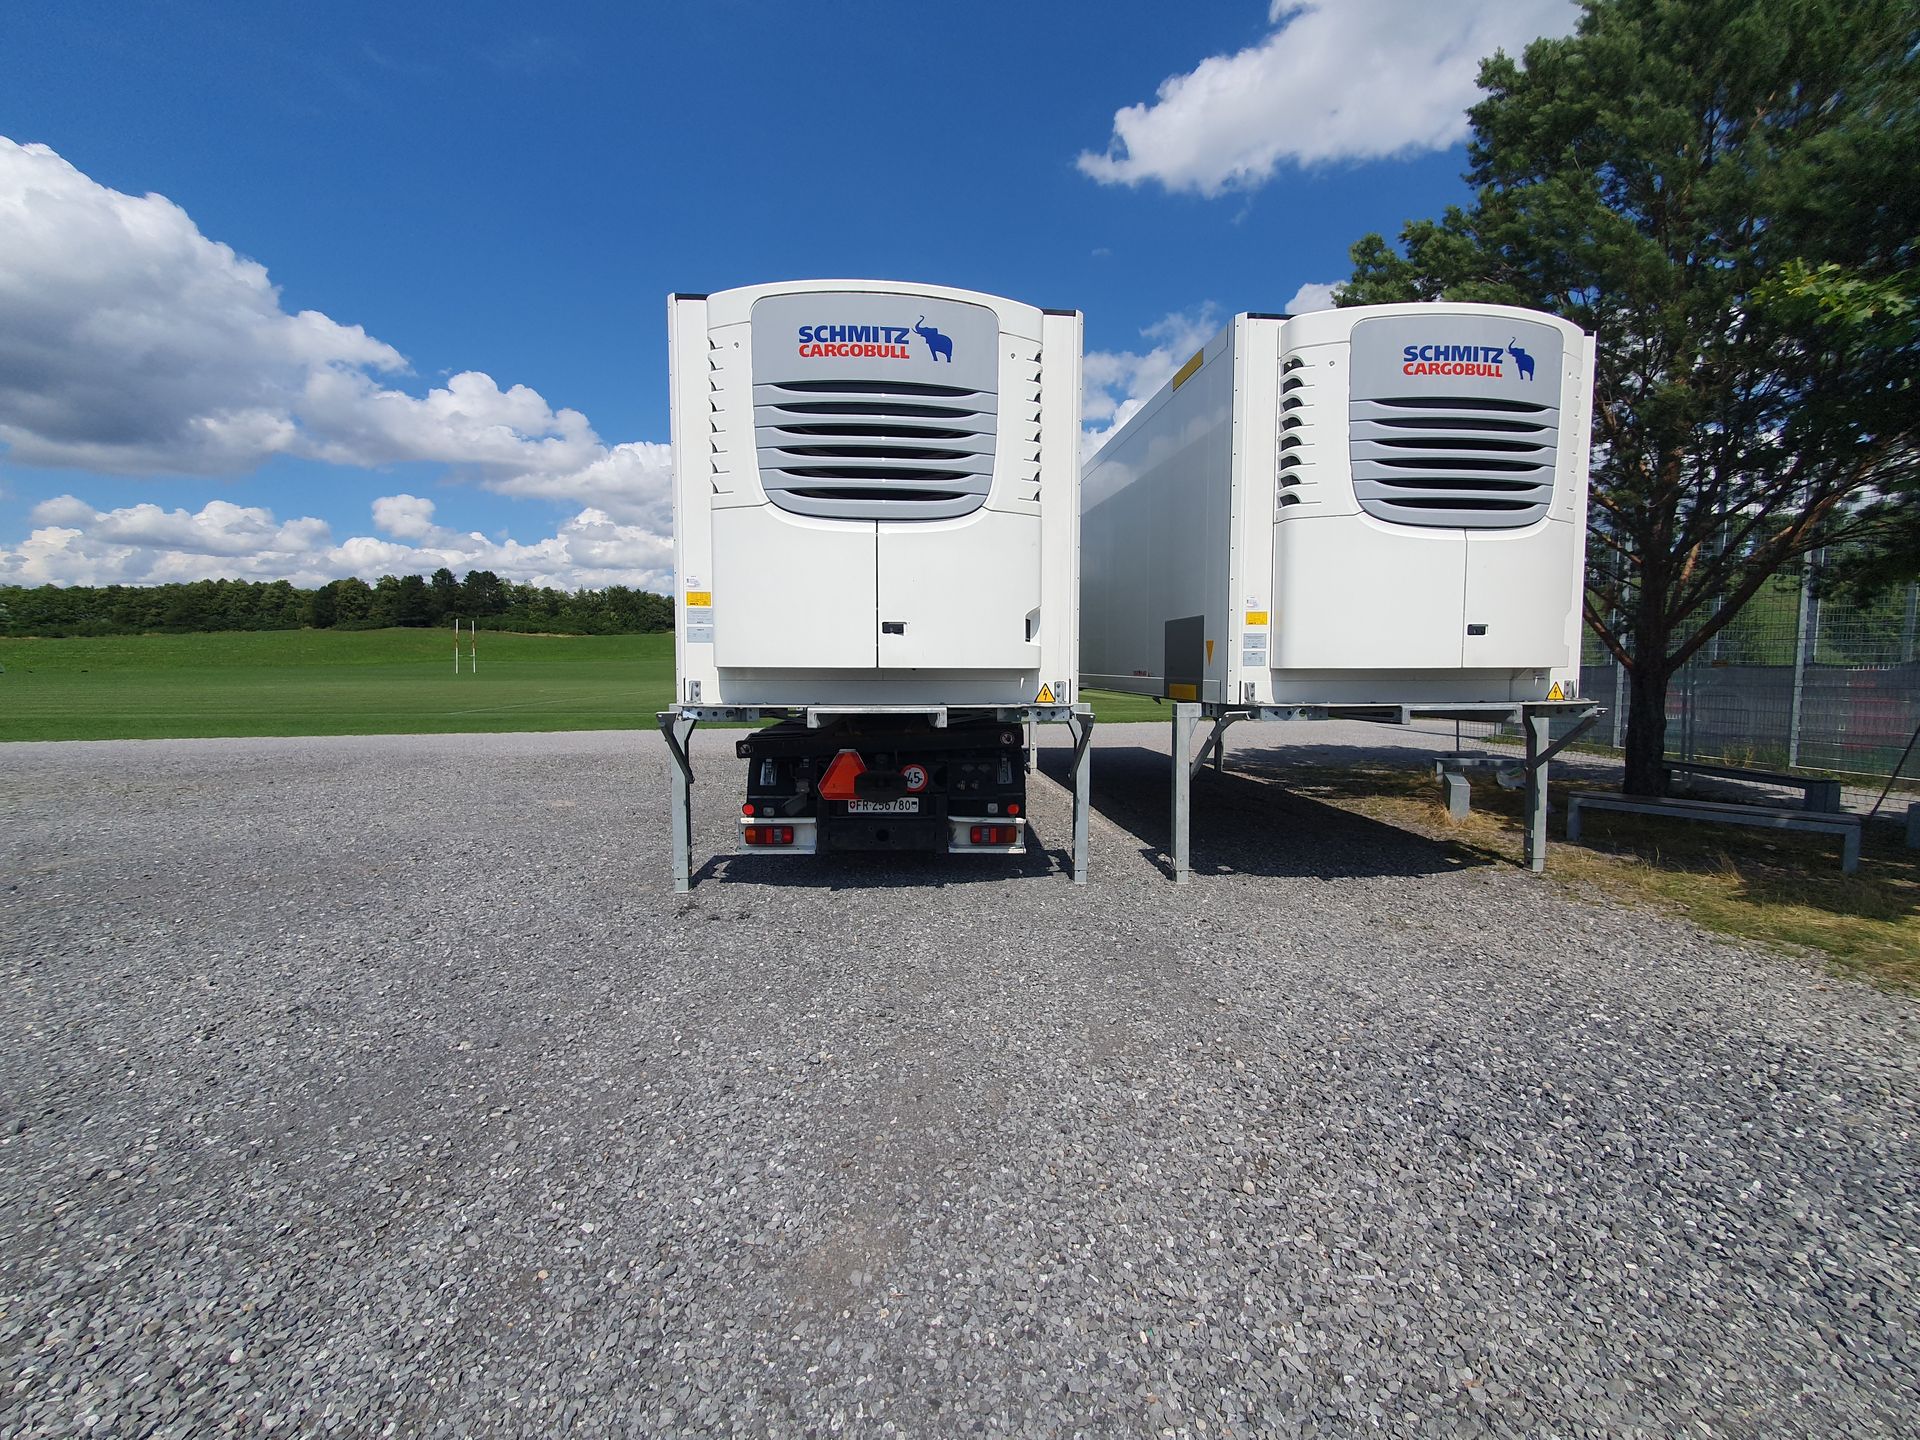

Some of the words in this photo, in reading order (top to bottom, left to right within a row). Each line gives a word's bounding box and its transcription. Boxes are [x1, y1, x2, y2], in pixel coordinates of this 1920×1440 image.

[799, 325, 910, 345] SCHMITZ
[799, 344, 910, 359] CARGOBULL
[1403, 345, 1504, 363] SCHMITZ
[1403, 362, 1503, 377] CARGOBULL
[906, 771, 921, 784] 45
